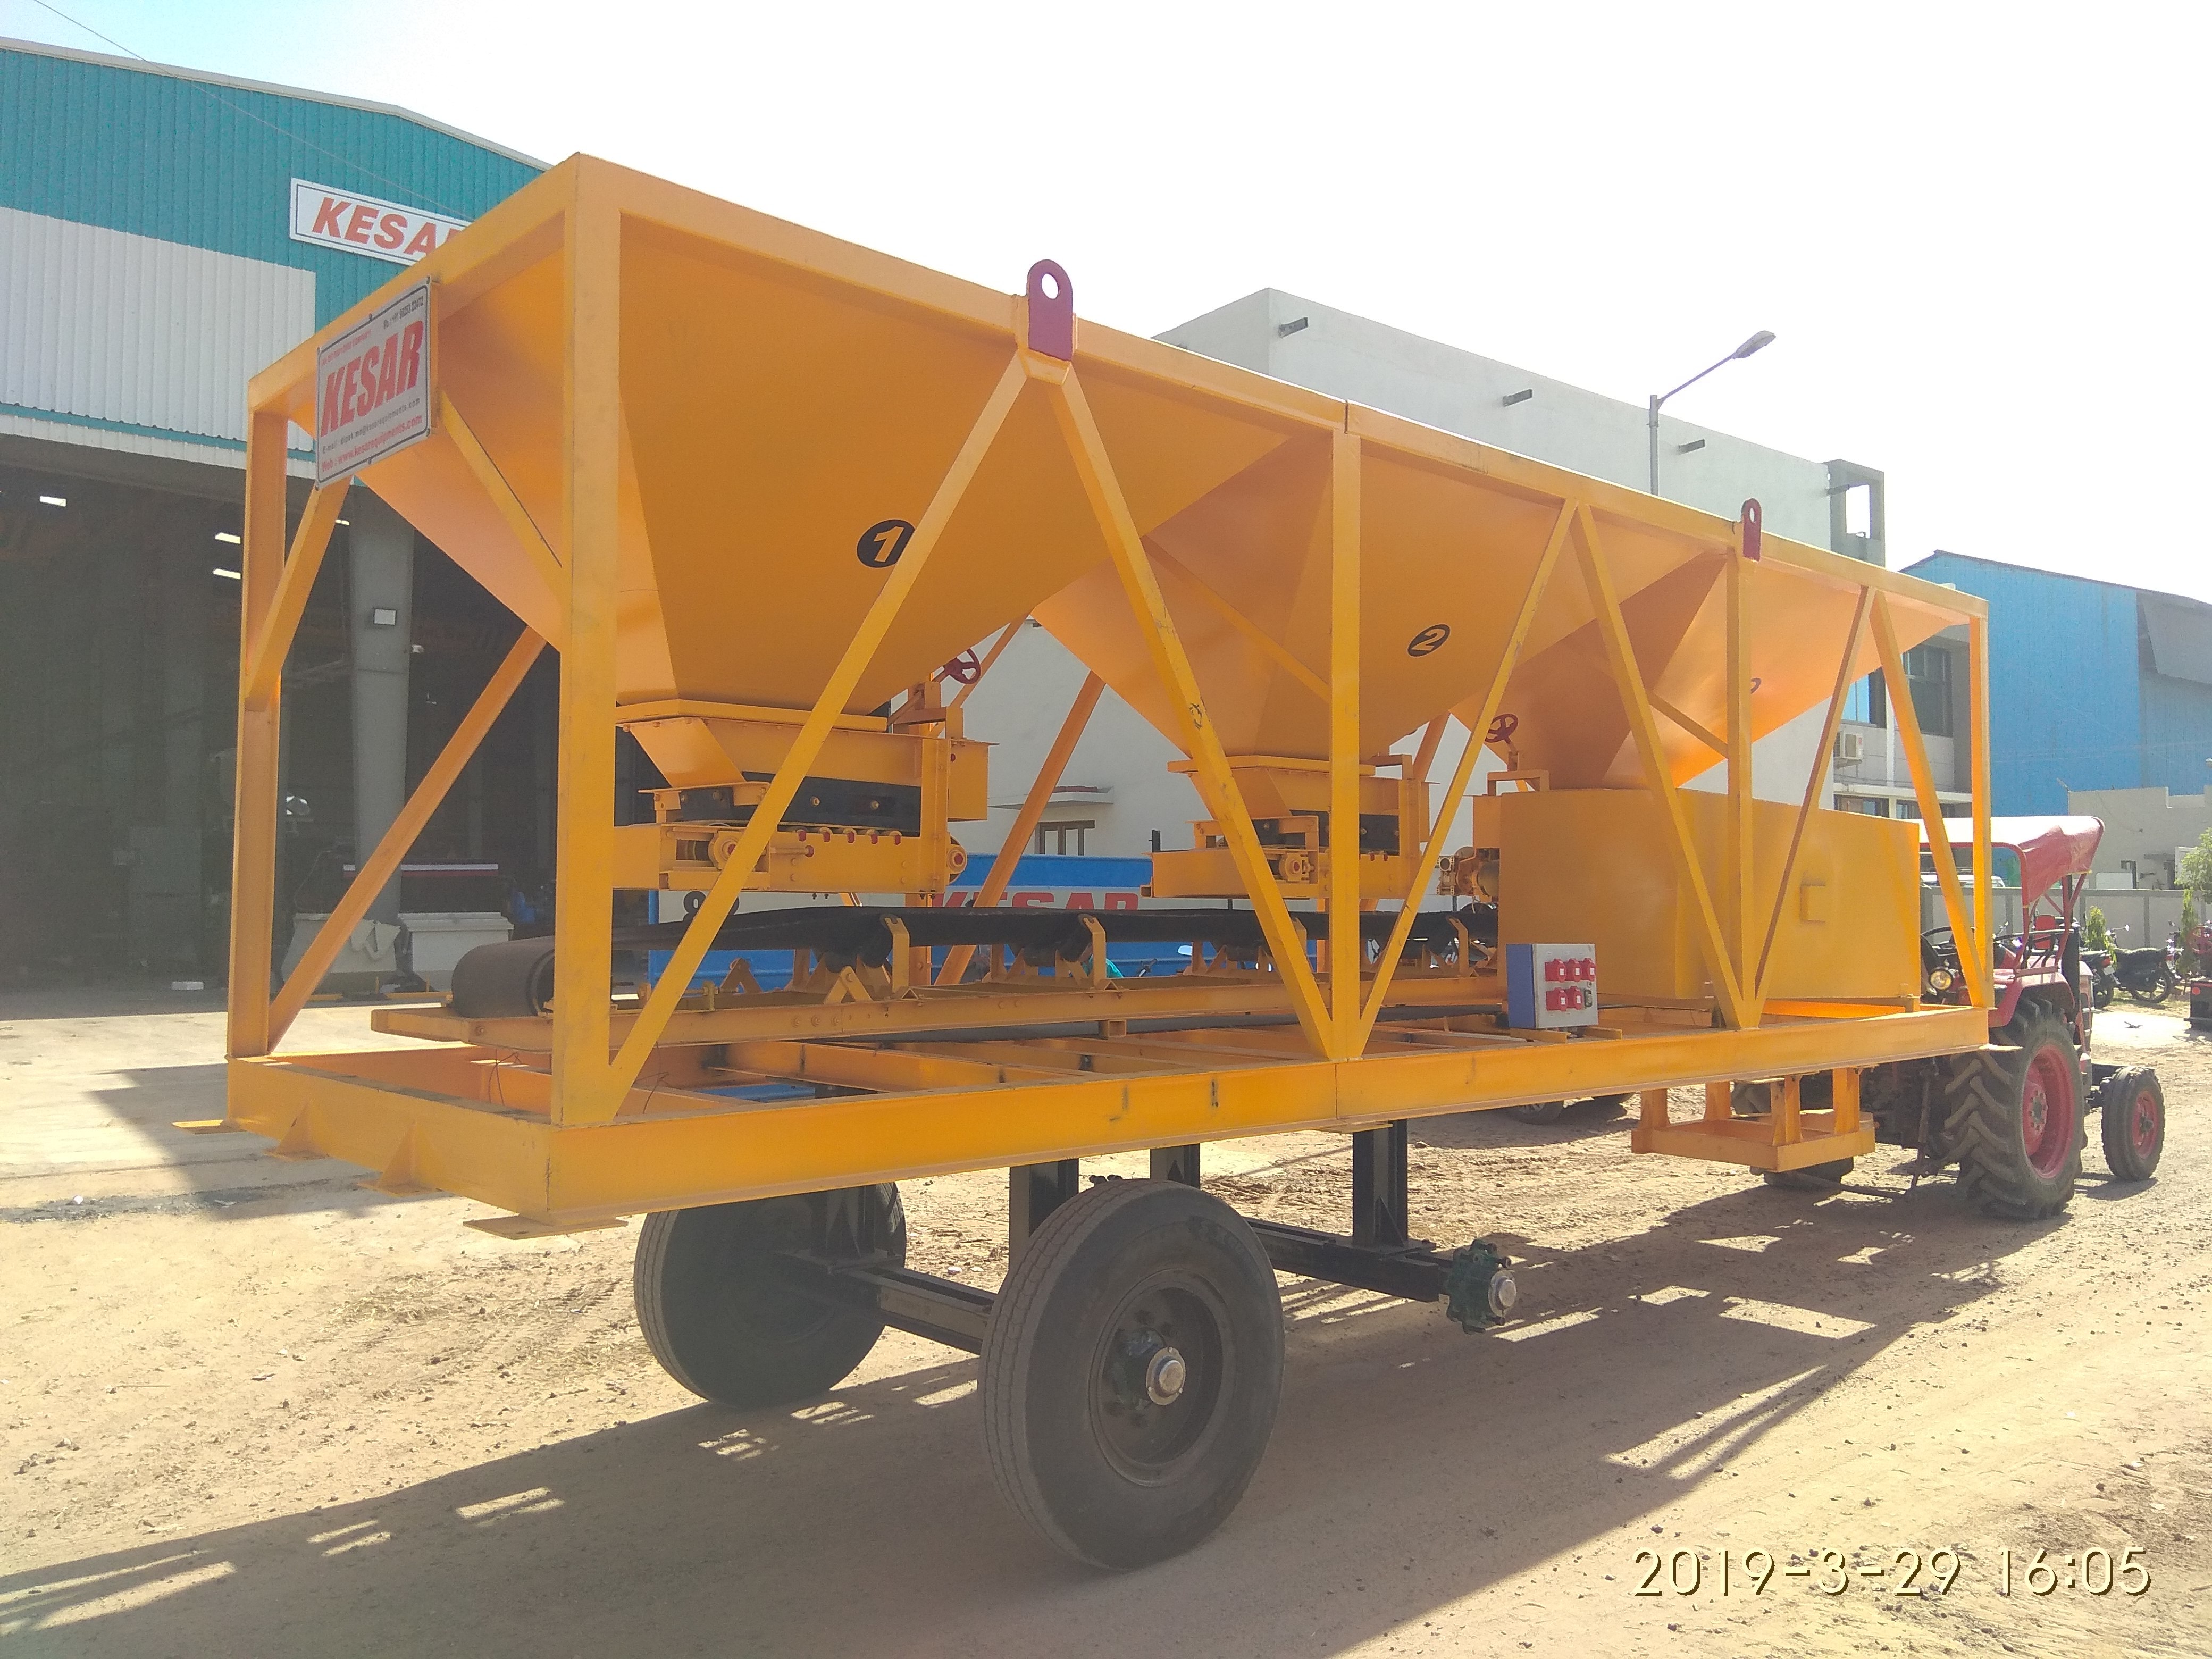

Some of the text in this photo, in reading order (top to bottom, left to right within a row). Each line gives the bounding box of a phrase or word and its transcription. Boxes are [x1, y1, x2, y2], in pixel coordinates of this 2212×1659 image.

[312, 197, 462, 255] KESA
[321, 320, 424, 437] KESAR
[874, 525, 904, 563] 1
[1411, 629, 1446, 651] 2
